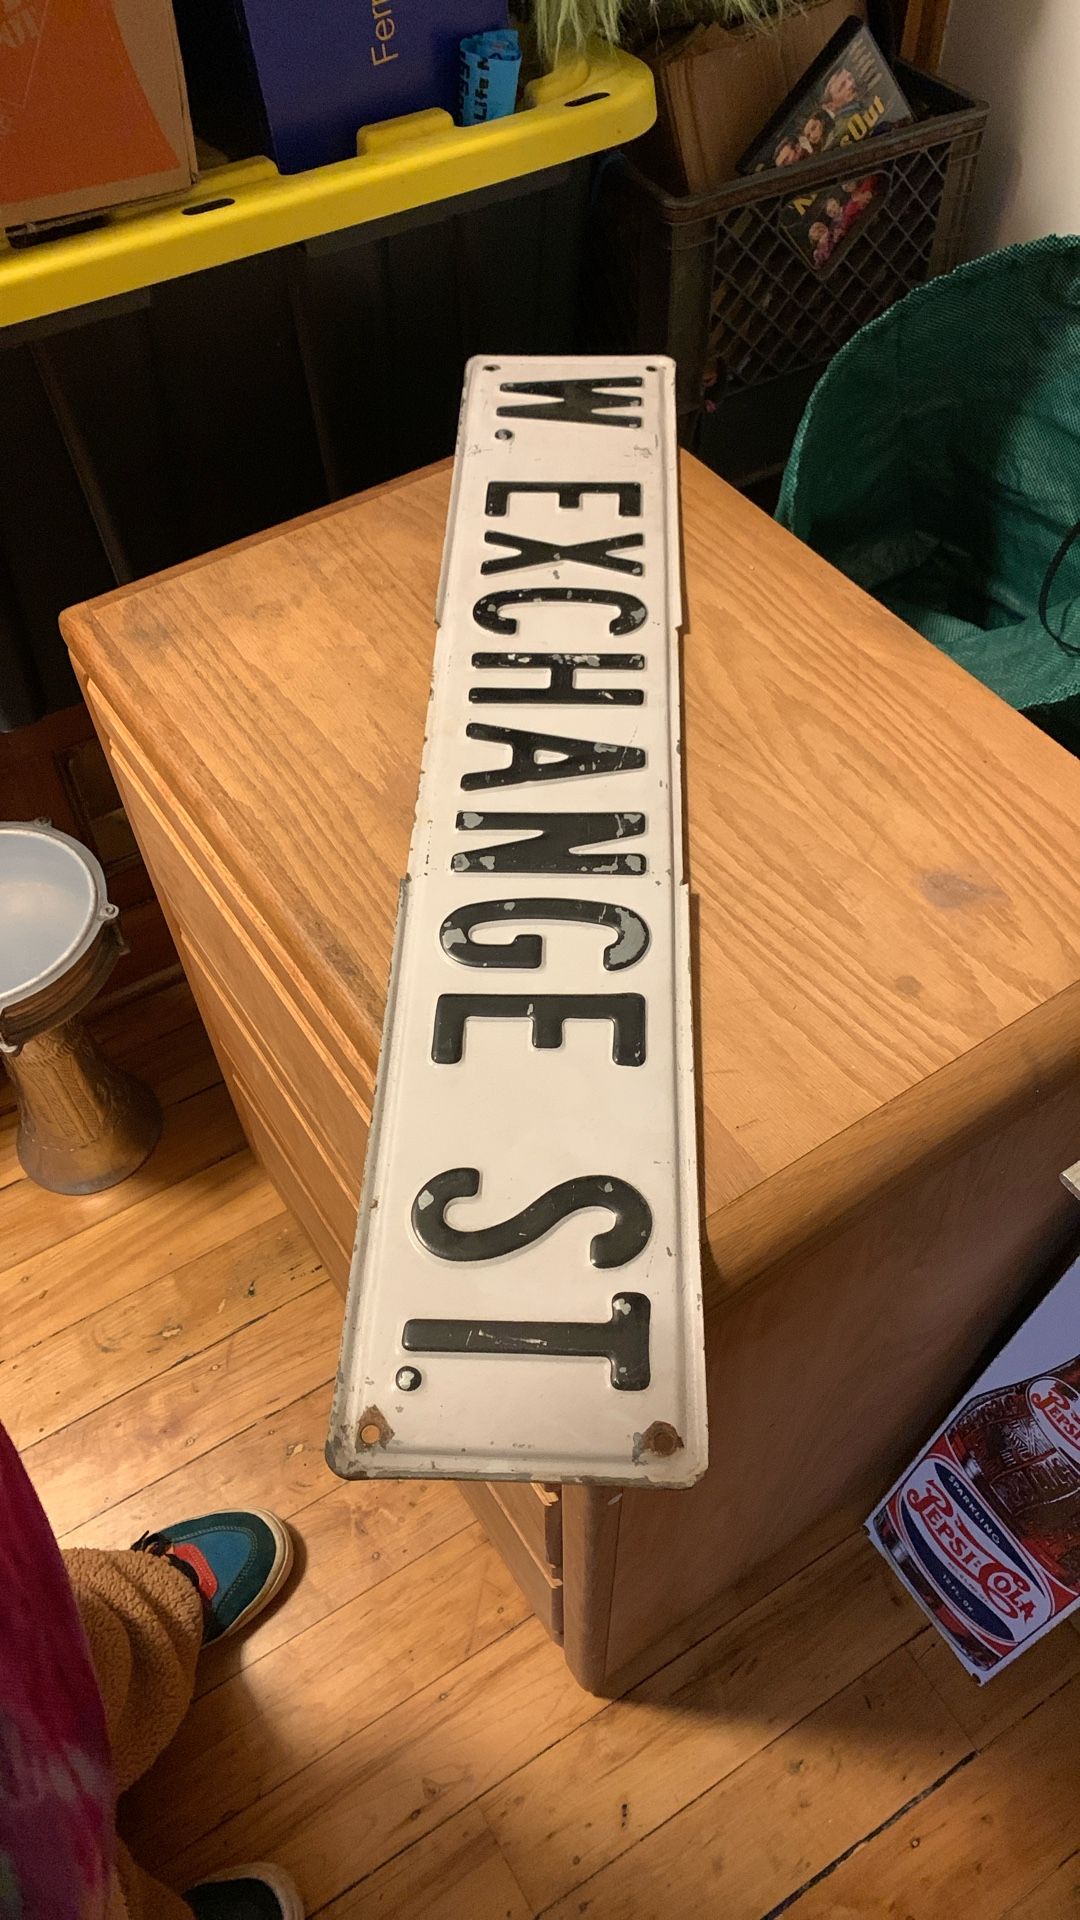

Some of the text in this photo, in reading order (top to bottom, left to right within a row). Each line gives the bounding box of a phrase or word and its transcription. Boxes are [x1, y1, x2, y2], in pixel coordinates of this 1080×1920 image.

[395, 376, 653, 1393] W. EXCHANGE ST.
[947, 1474, 1001, 1545] SPARKLING
